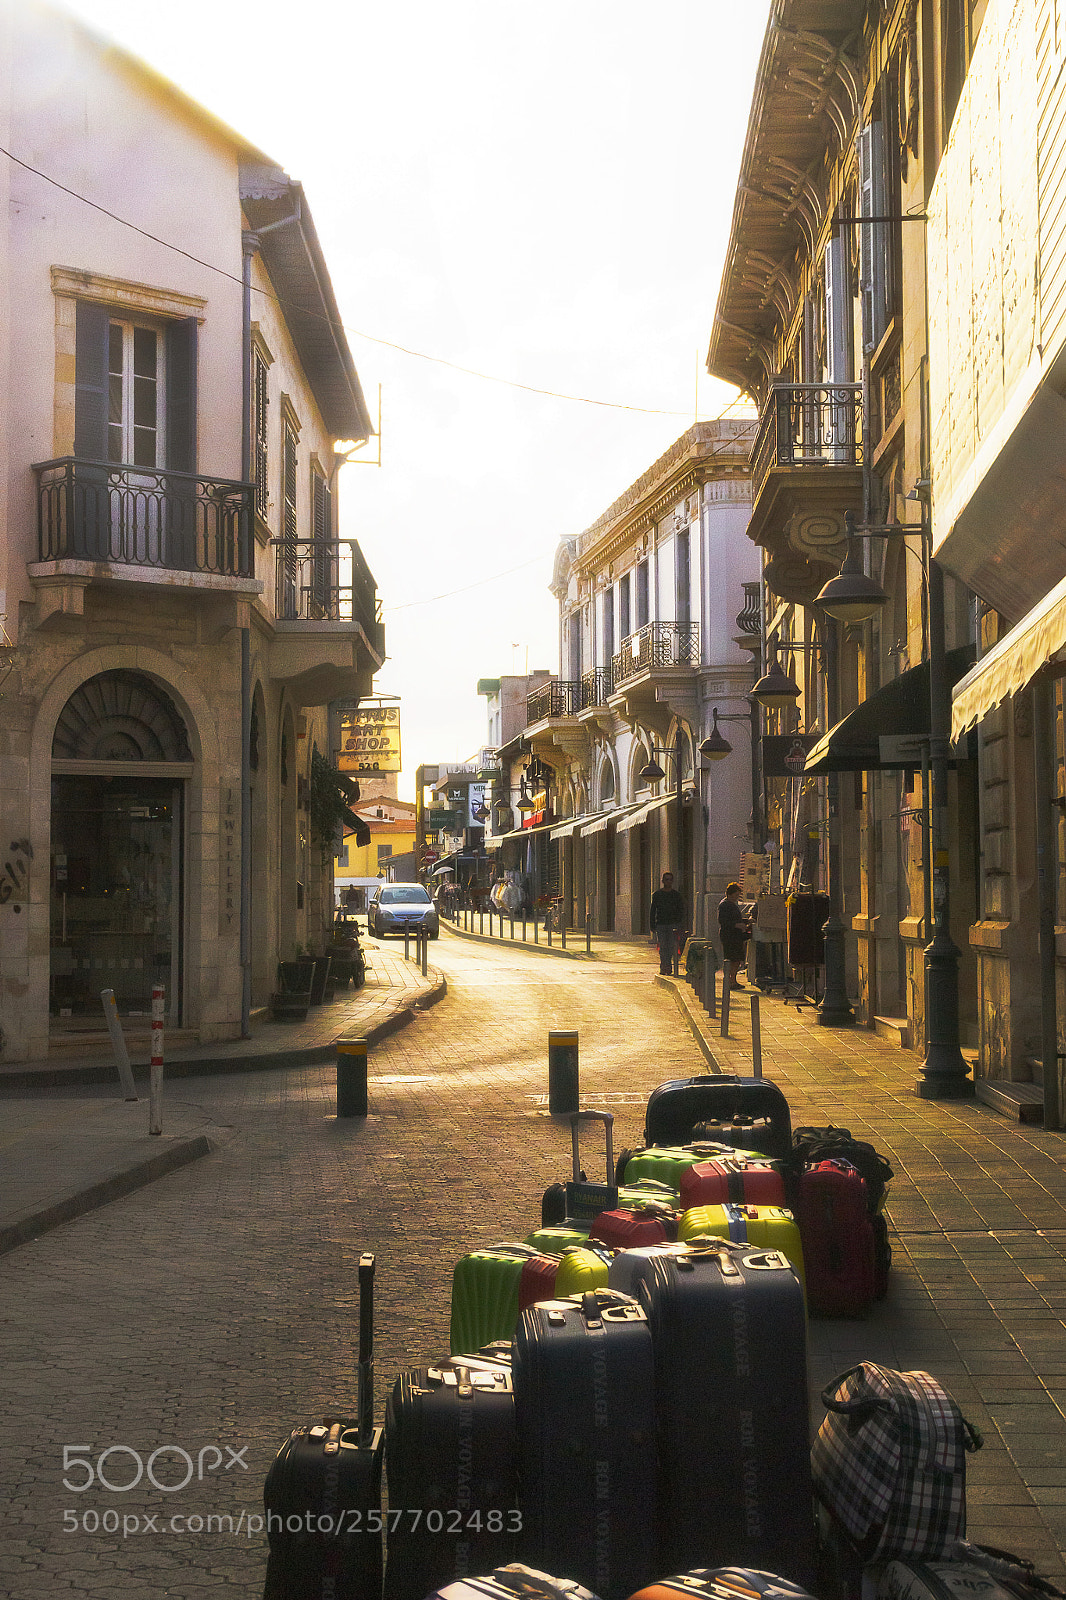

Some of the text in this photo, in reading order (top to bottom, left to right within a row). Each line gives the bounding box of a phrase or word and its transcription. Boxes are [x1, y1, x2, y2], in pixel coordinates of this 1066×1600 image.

[345, 738, 391, 750] SHOP
[350, 724, 385, 736] ART
[224, 788, 235, 925] JEWELLERY
[574, 1192, 607, 1205] RYANAIR
[732, 1298, 750, 1378] VOYAGE
[592, 1348, 608, 1427] VOYAGE
[456, 1436, 475, 1510] VOYAGE
[595, 1461, 610, 1499] BON
[740, 1410, 762, 1537] BON VOYAGE
